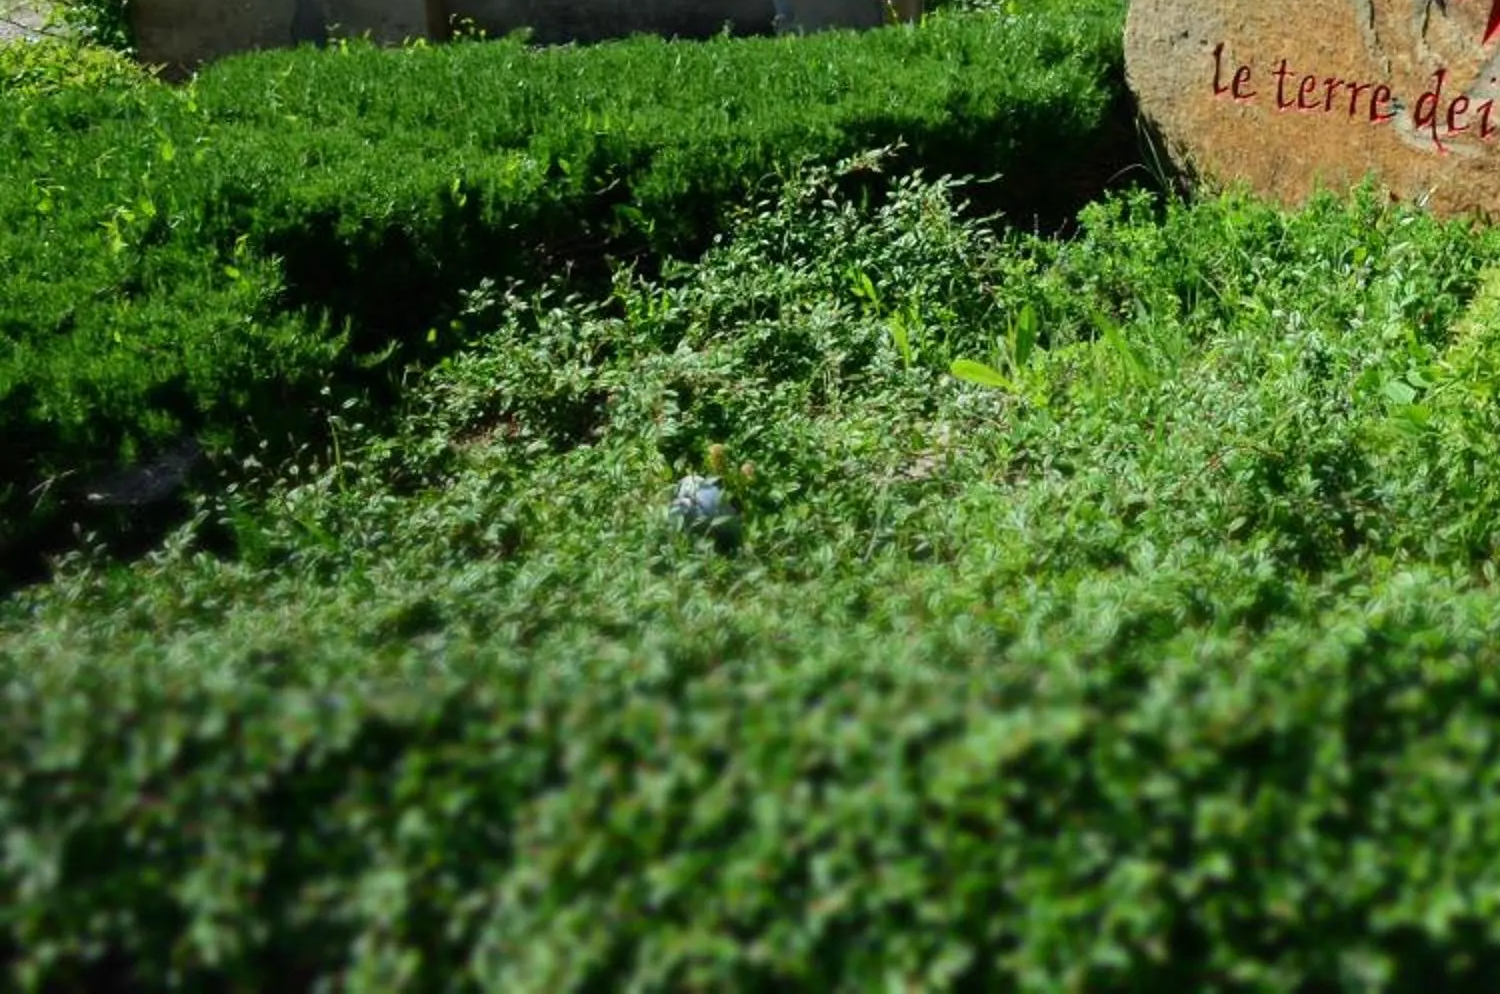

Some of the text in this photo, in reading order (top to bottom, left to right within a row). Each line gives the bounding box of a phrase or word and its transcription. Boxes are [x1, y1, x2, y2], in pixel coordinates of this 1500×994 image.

[1211, 42, 1257, 101] le
[1272, 58, 1397, 122] terre
[1413, 68, 1497, 155] dei
